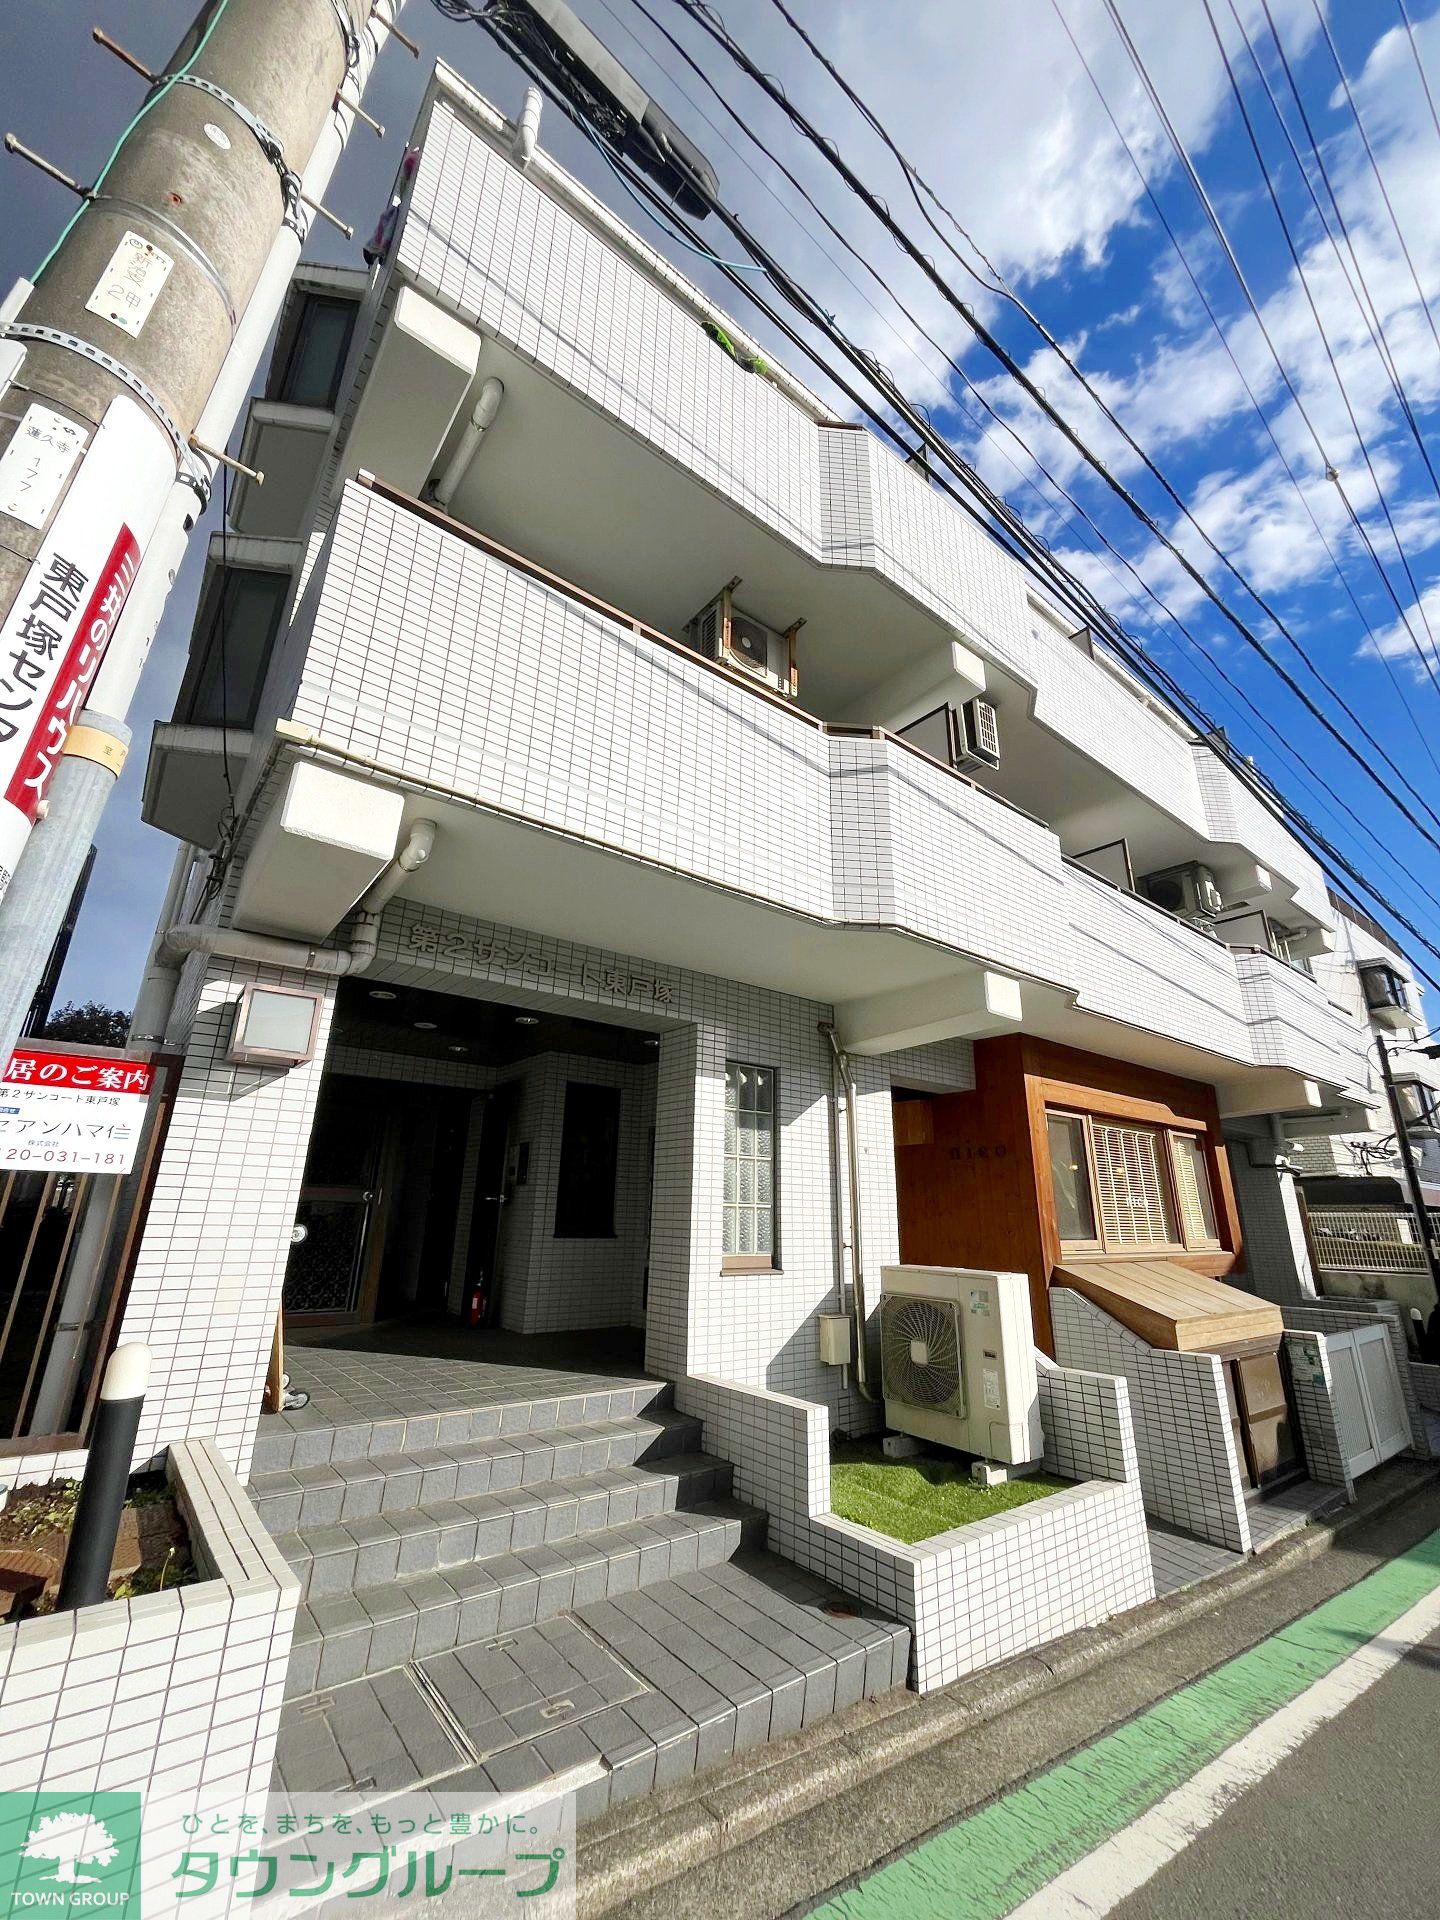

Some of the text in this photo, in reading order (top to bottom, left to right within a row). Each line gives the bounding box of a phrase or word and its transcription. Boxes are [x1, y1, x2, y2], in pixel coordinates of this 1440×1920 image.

[107, 283, 141, 308] 2甲
[24, 553, 136, 799] 三井のリハウス
[407, 922, 673, 1004] 第2サンコート東戸塚
[4, 1057, 150, 1091] 居のご案内
[0, 1148, 125, 1165] 20-031-181
